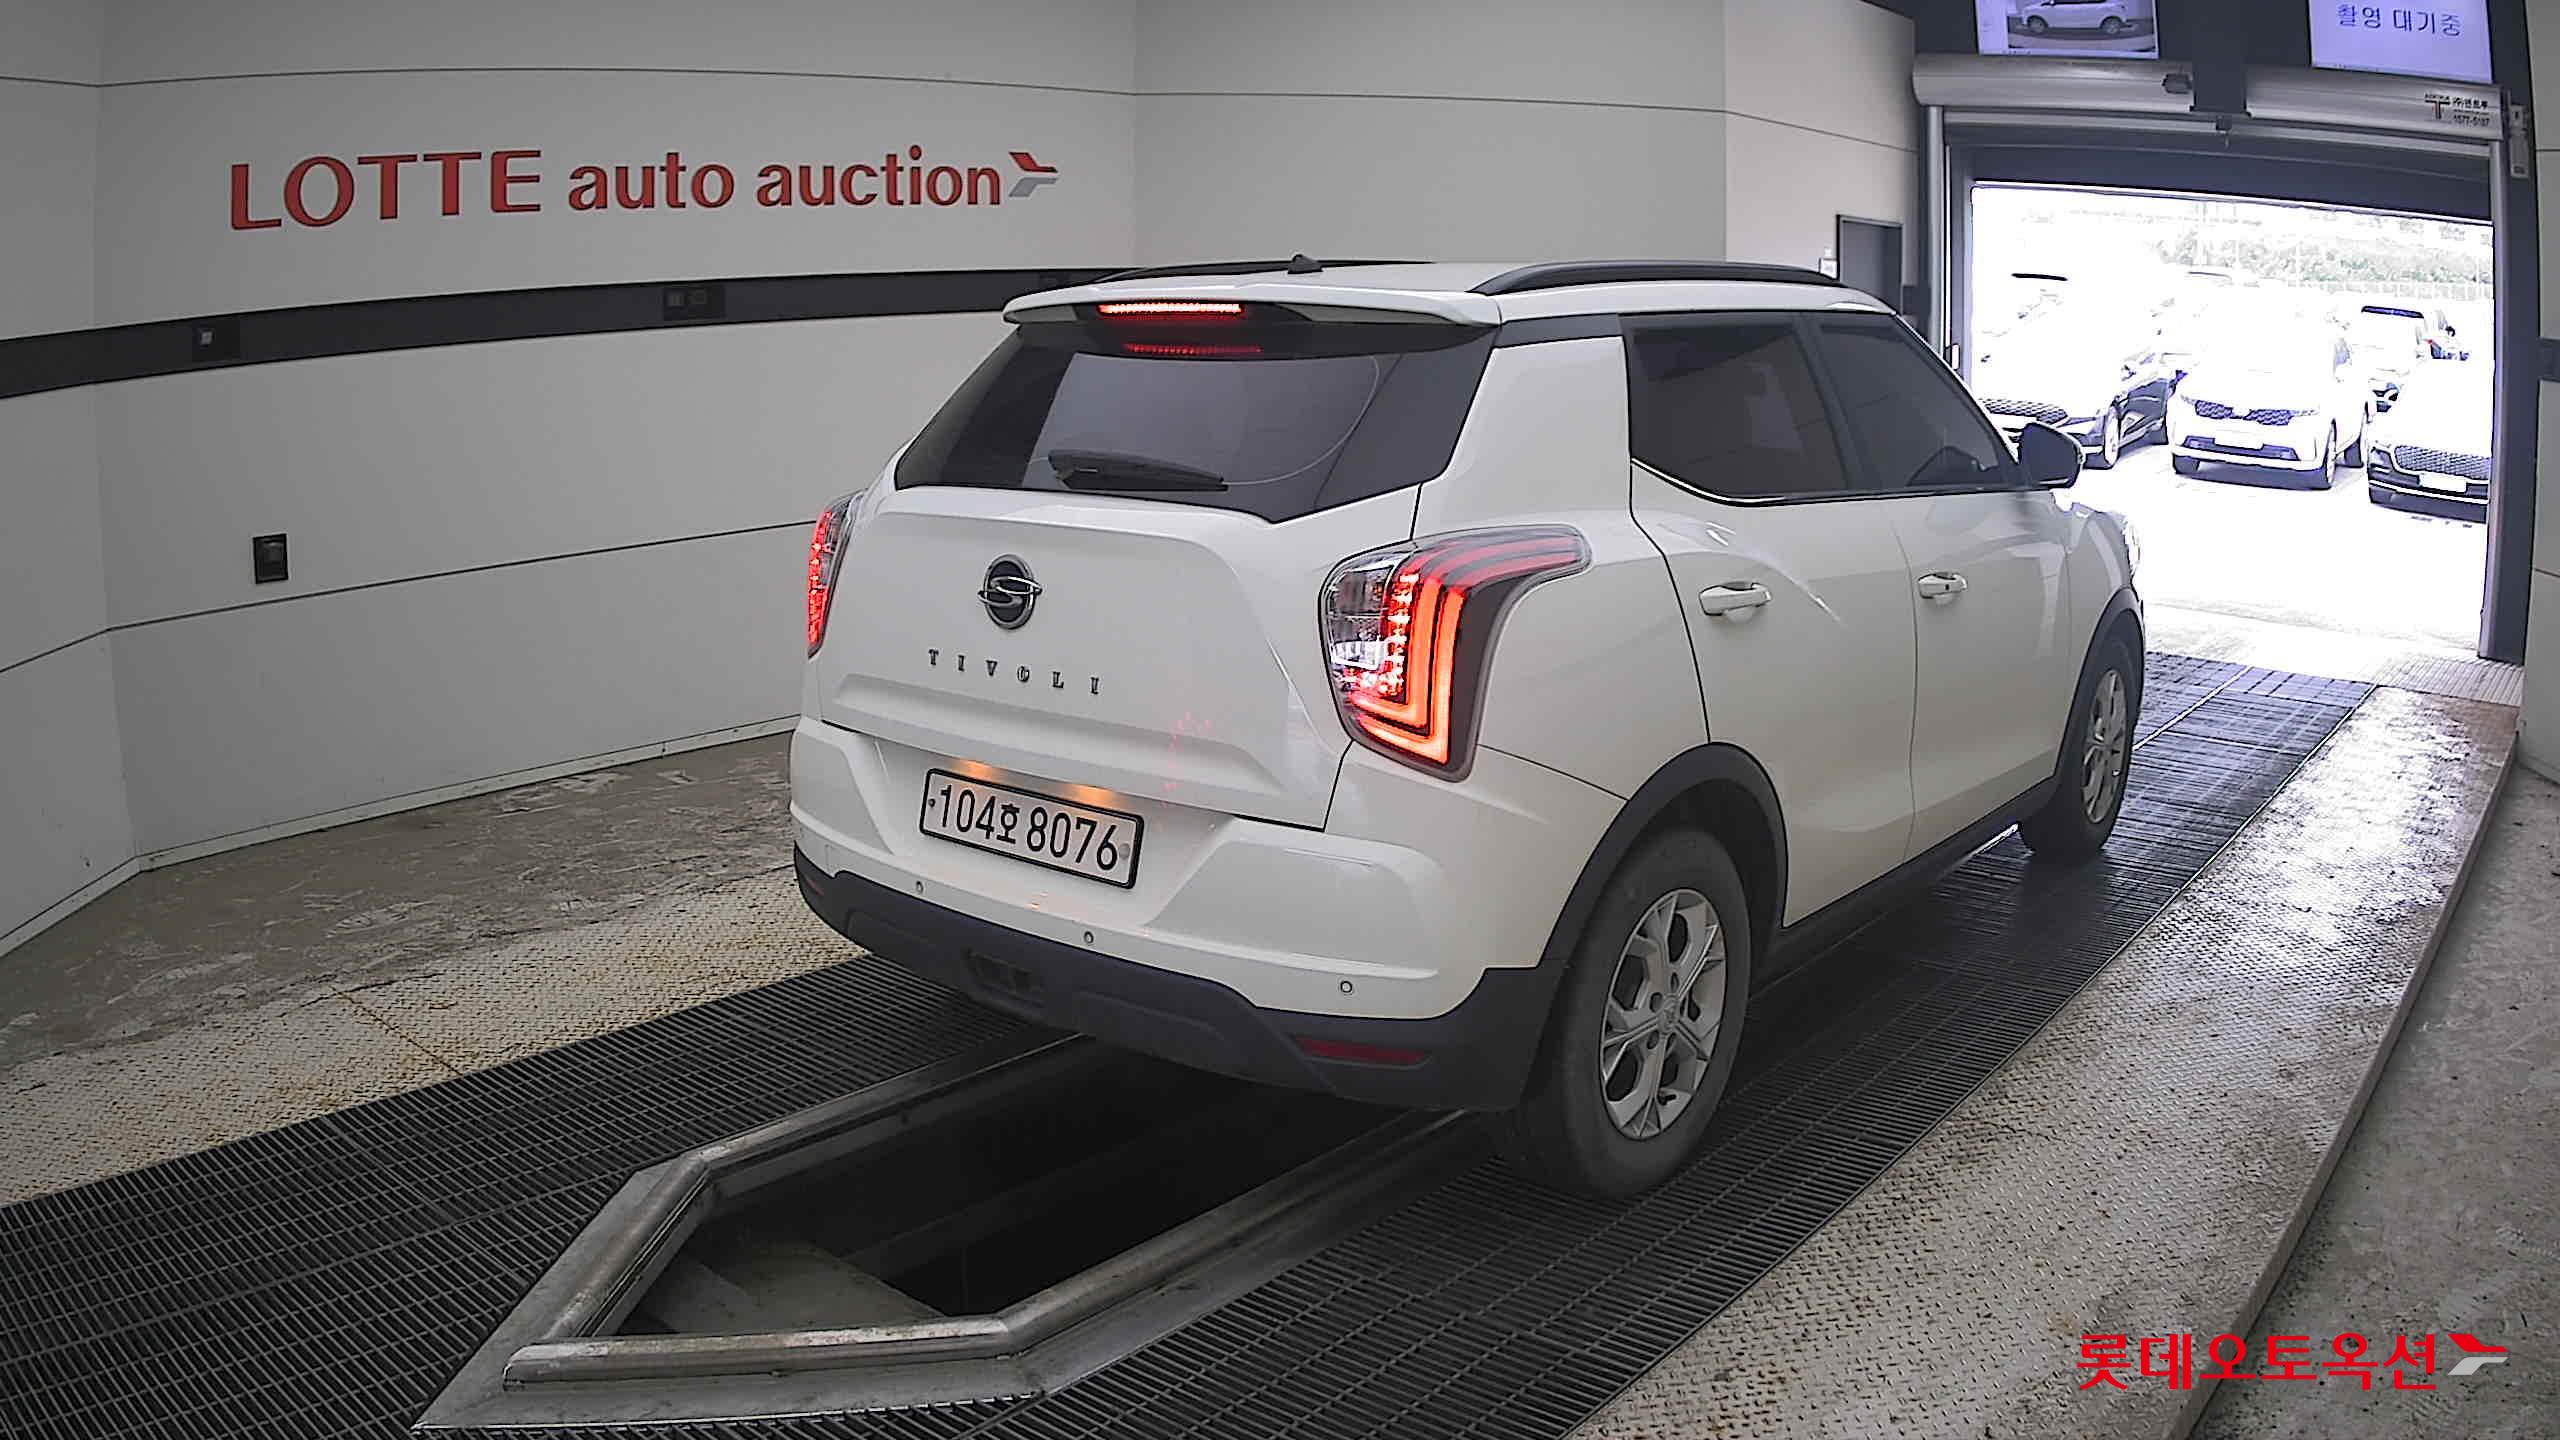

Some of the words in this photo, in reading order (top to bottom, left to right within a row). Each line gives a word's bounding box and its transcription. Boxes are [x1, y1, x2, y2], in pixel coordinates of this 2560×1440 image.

[2337, 3, 2382, 29] 촬영
[2392, 8, 2461, 37] 대기중
[229, 149, 543, 232] LOTTE
[567, 151, 736, 211] auto
[755, 145, 1002, 208] auction
[928, 649, 1101, 695] TIVOLI
